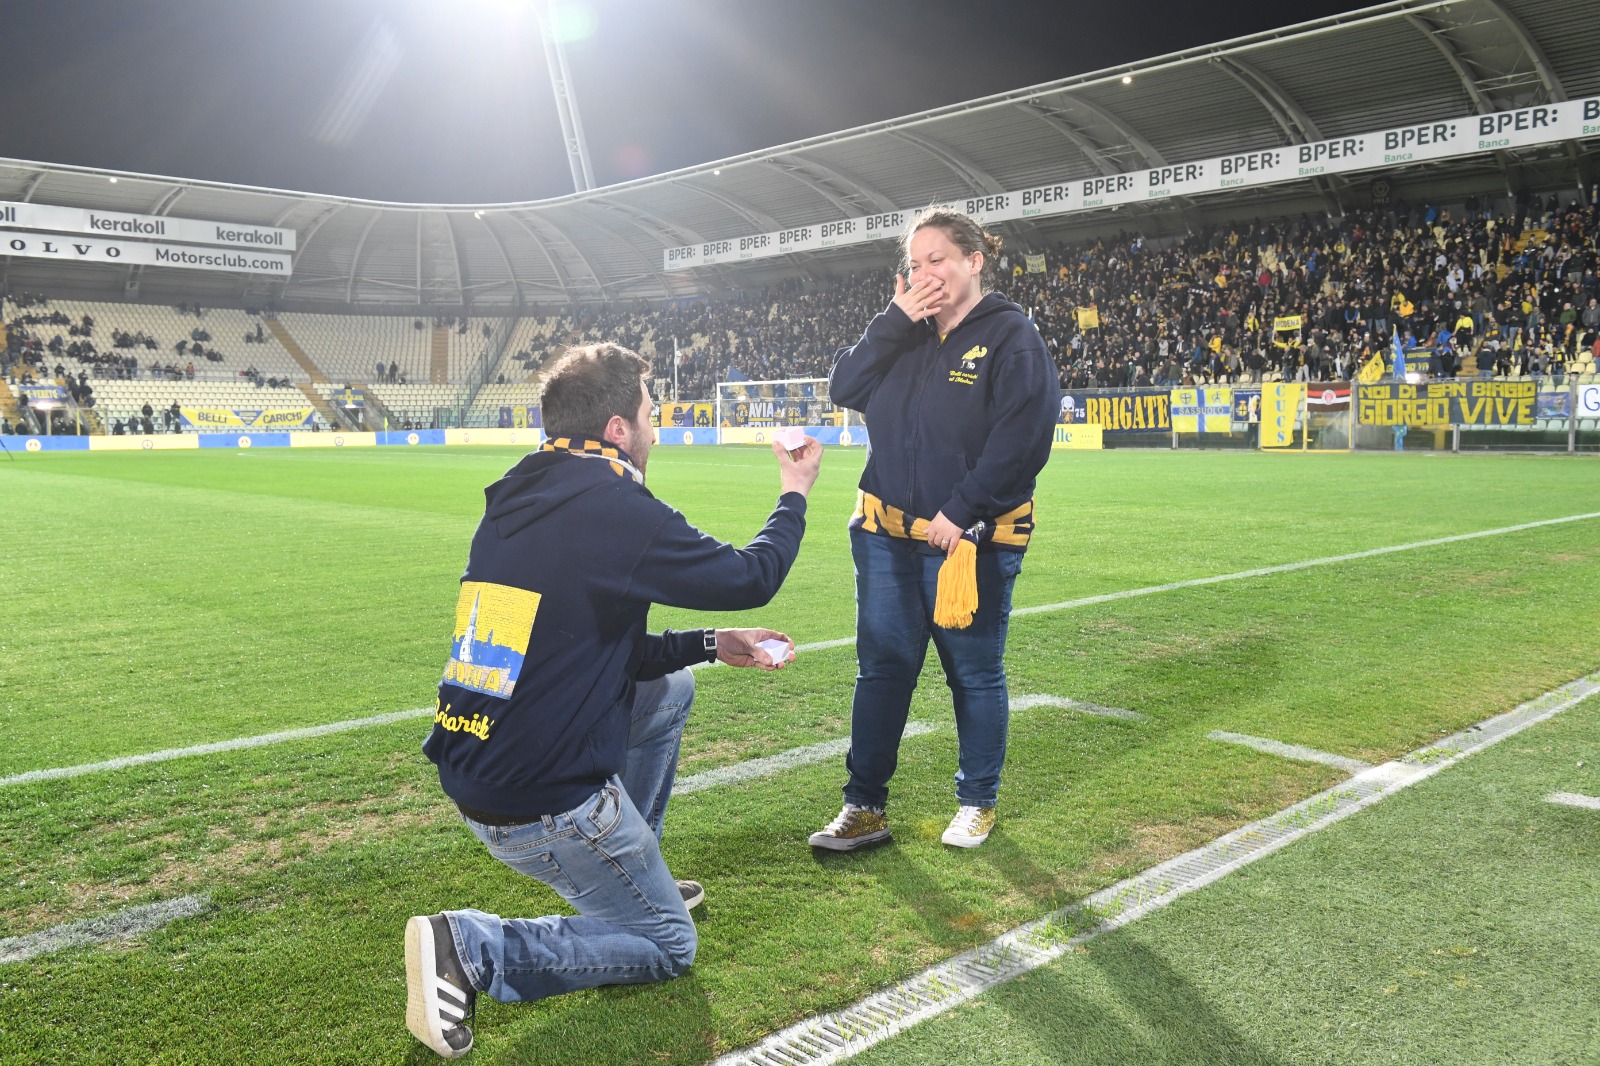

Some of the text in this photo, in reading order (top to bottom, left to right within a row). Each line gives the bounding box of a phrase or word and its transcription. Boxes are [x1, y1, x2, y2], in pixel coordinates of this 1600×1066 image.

[1583, 99, 1600, 121] B
[1479, 107, 1558, 136] BPER:
[1384, 123, 1456, 151] BPER:
[1478, 138, 1510, 149] Banca
[1299, 138, 1364, 164] BPER:
[1384, 152, 1413, 163] Banca
[1220, 152, 1280, 176] BPER:
[1298, 165, 1325, 176] Banca
[1149, 164, 1203, 187] BPER:
[1220, 177, 1244, 187] Banca
[1083, 175, 1133, 197] BPER:
[1148, 189, 1171, 198] Banca
[1022, 185, 1069, 206] BPER:
[1082, 198, 1103, 207] Banca
[90, 214, 165, 236] kerakoll
[821, 220, 856, 238] BPER:
[866, 213, 903, 231] BPER:
[216, 226, 283, 246] kerakoll
[740, 235, 771, 251] BPER:
[779, 228, 812, 245] BPER:
[10, 239, 121, 258] OLVO
[669, 247, 696, 261] BPER:
[703, 241, 732, 256] BPER:
[155, 248, 284, 271] Motorsclub.com
[1275, 319, 1300, 328] MODENA
[1358, 381, 1536, 399] NOI DI SAN BIAGIO
[1075, 407, 1086, 418] 75
[1085, 395, 1170, 430] BRIGATE
[1179, 406, 1224, 416] SASSUOLO
[1359, 397, 1536, 426] GIORGIO VIVE
[1053, 427, 1073, 443] lle
